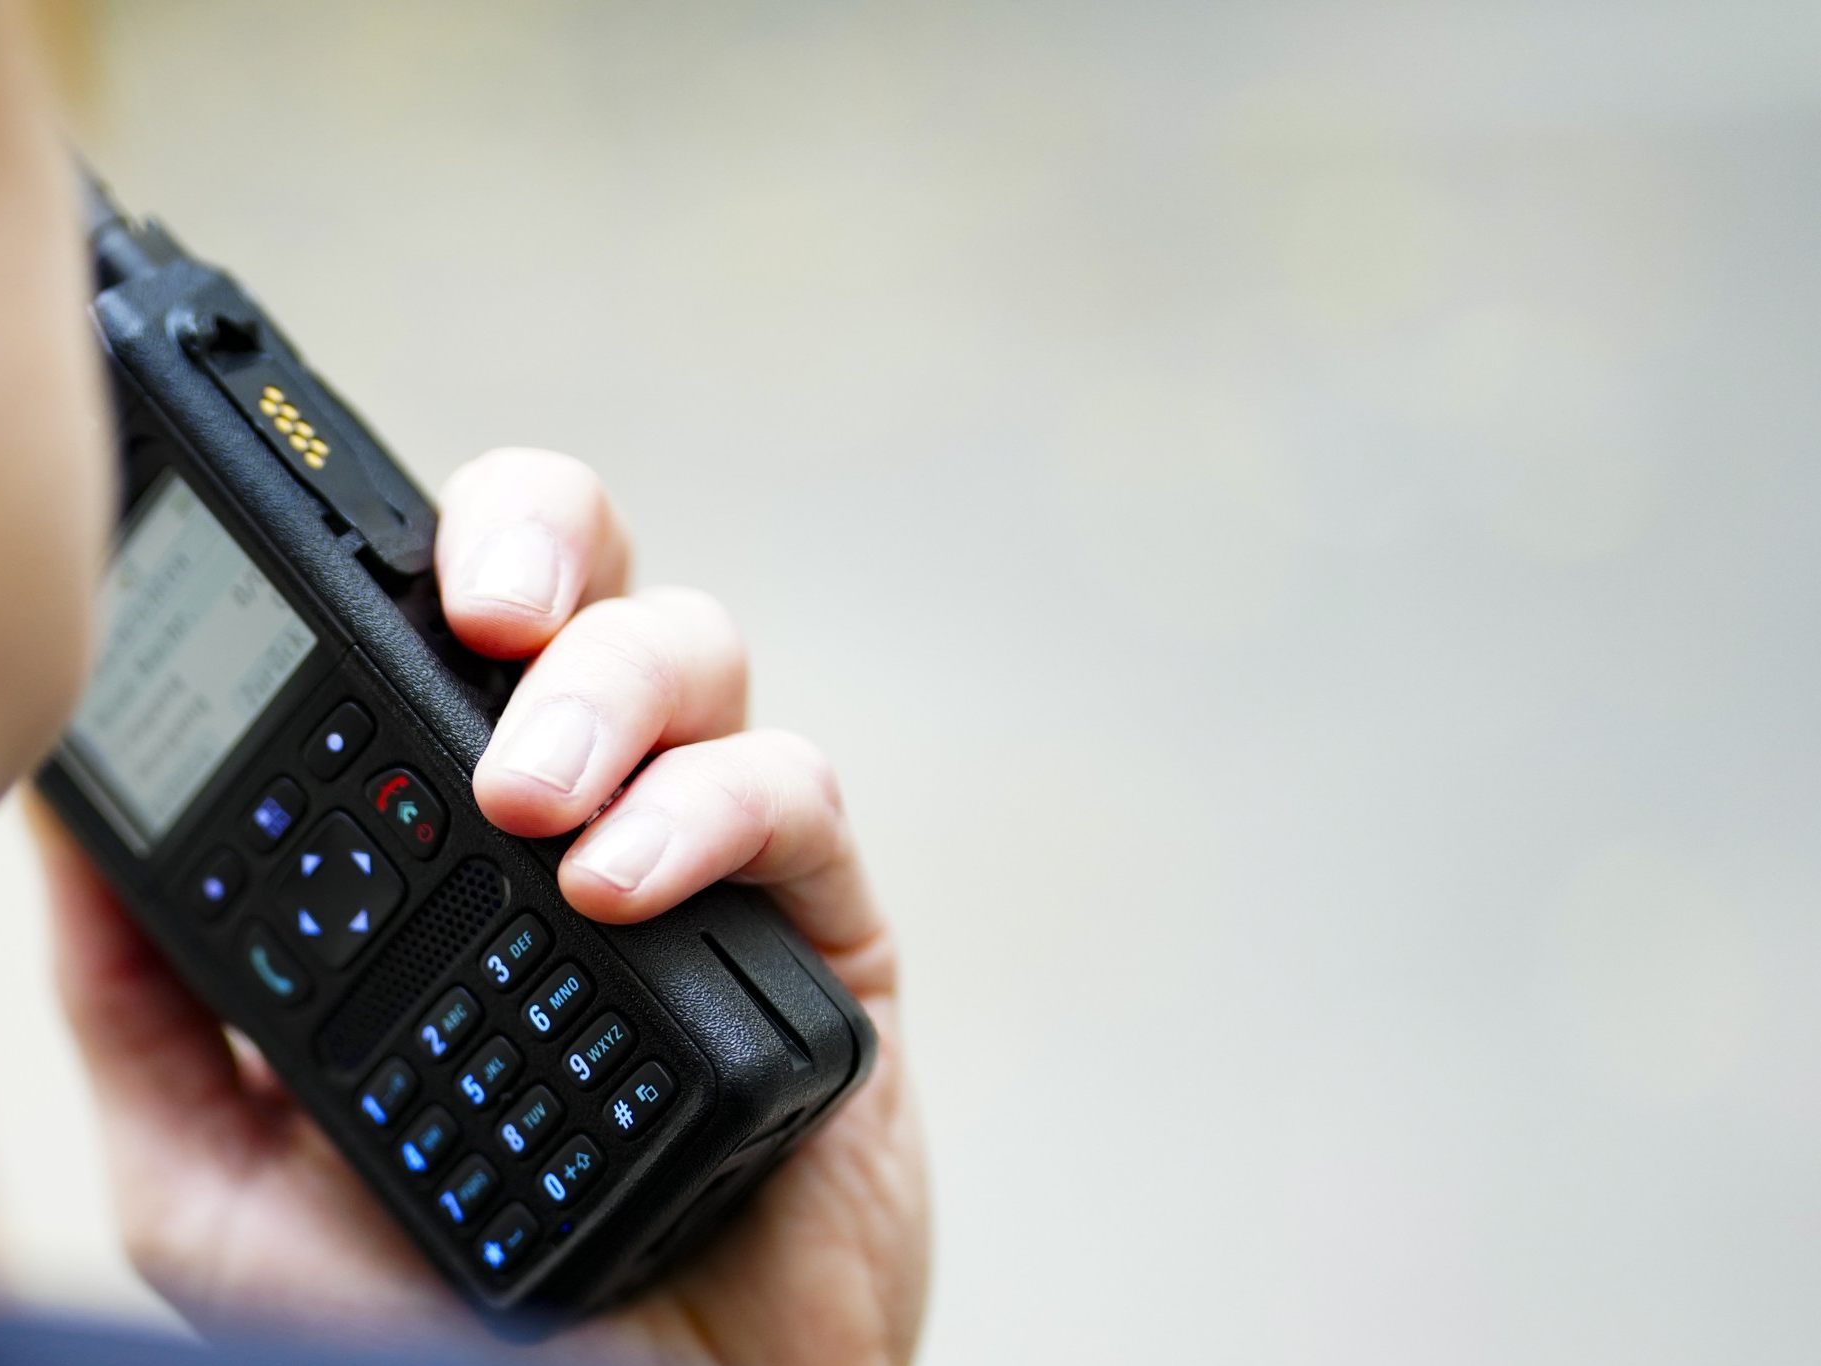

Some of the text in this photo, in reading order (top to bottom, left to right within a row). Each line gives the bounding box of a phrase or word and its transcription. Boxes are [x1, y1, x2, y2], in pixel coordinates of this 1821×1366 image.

[487, 930, 534, 983] 3 DEF
[528, 976, 579, 1032] 6 MNO
[422, 1003, 468, 1056] 2 ABC
[569, 1024, 624, 1081] 9 WXYZ
[460, 1056, 507, 1105] 5 JKL
[361, 1094, 387, 1125] 1
[501, 1101, 547, 1152] 8 TUV
[613, 1099, 634, 1130] #
[401, 1141, 428, 1172] 4
[438, 1190, 465, 1223] 7
[542, 1171, 566, 1201] 0
